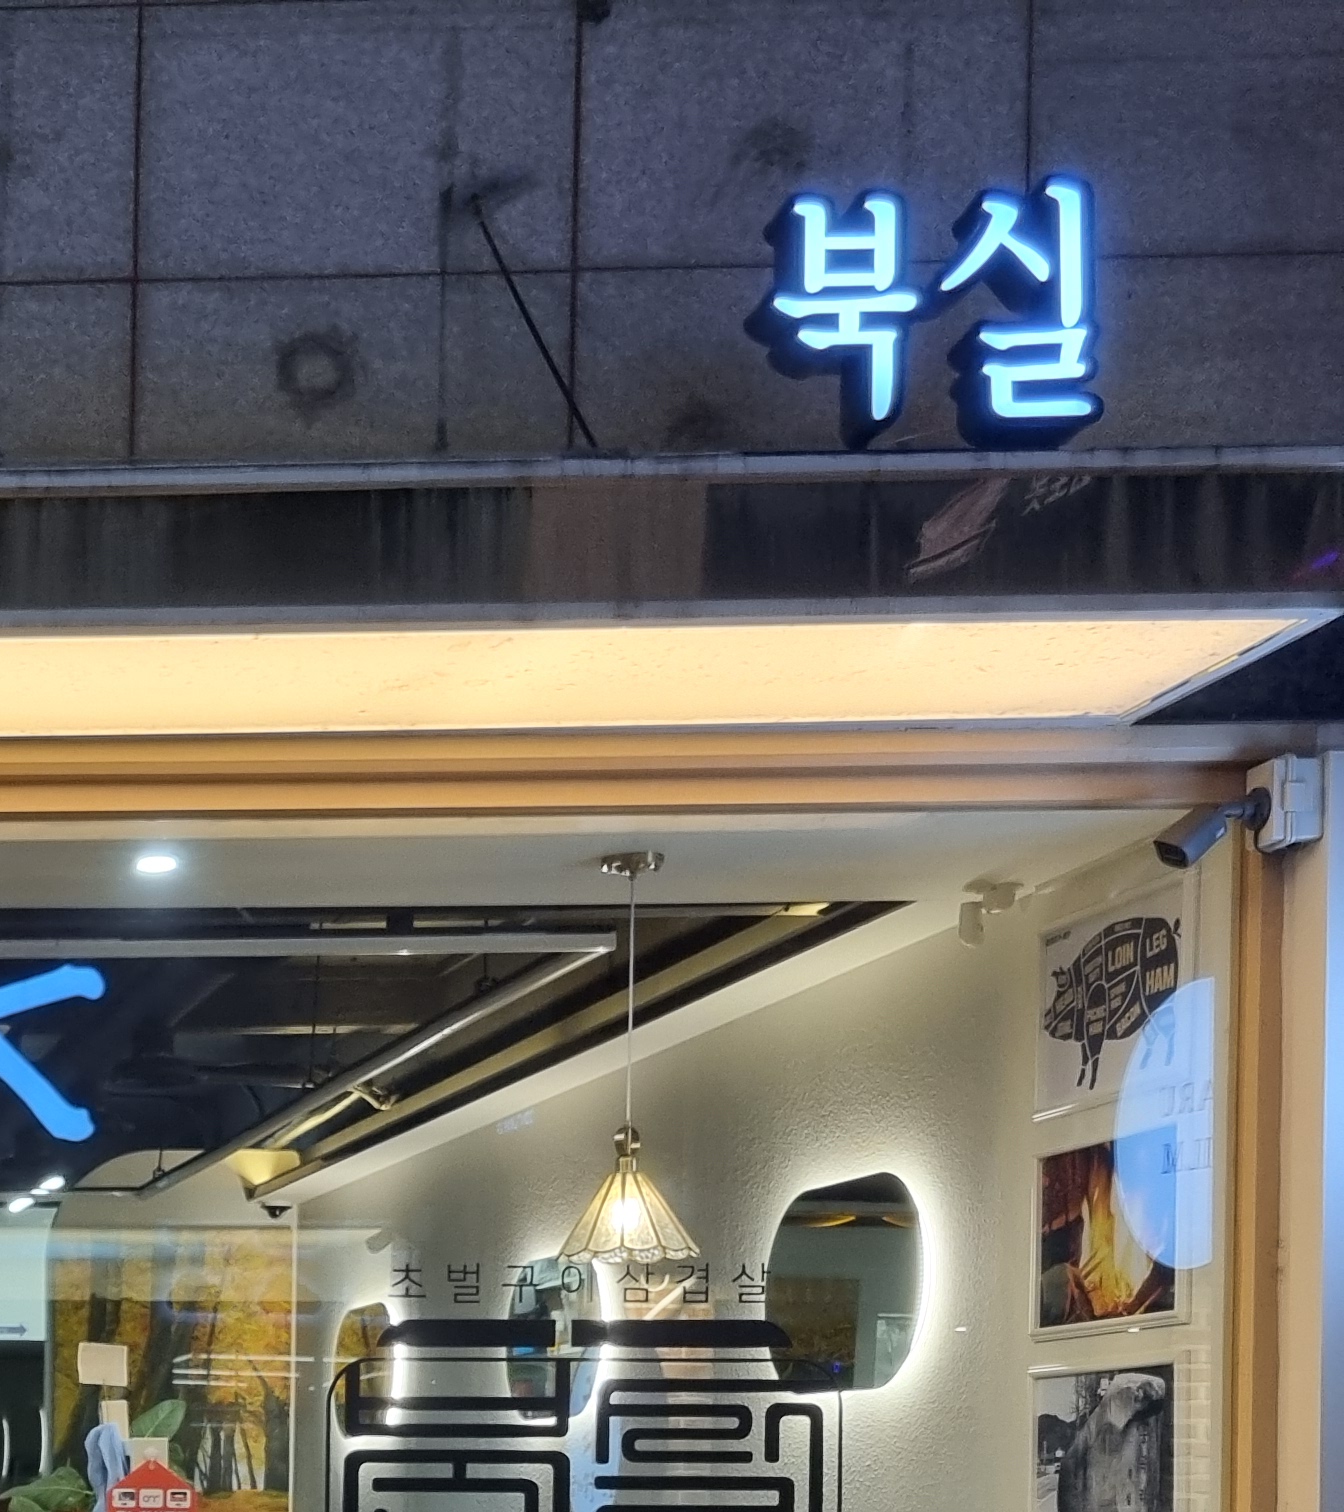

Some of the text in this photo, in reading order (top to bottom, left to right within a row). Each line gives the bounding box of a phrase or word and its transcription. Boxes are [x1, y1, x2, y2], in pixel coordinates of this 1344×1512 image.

[773, 183, 1093, 422] 북실
[1145, 963, 1175, 997] HAM
[387, 1261, 771, 1305] 초벌구이삼겹살
